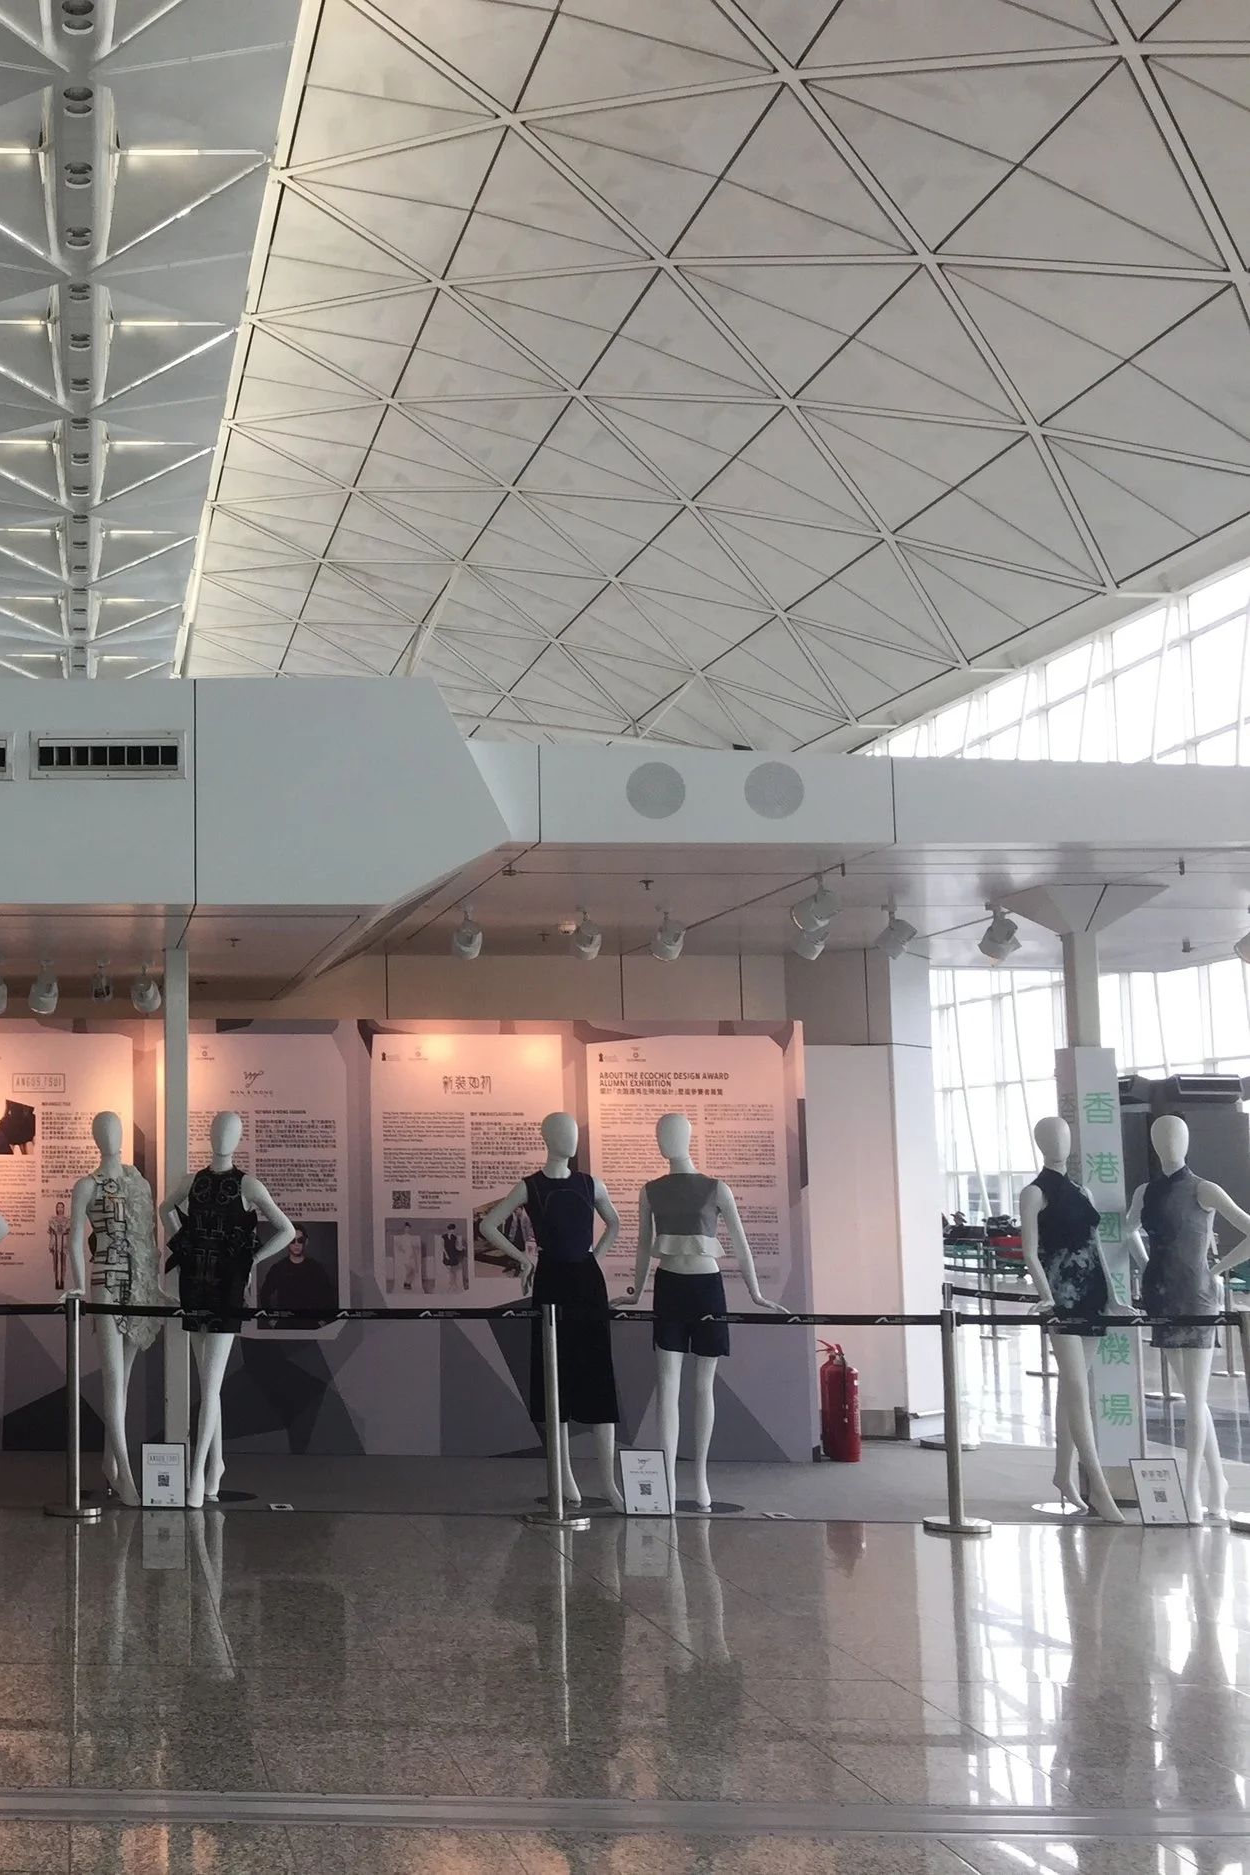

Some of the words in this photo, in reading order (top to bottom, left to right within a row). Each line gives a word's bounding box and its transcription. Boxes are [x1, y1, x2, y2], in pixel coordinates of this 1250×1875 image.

[599, 1072, 623, 1080] ABOUT
[625, 1072, 638, 1080] THE
[640, 1072, 672, 1080] ECOCHIC
[673, 1072, 700, 1080] DESIGN
[702, 1072, 729, 1080] AWARD
[599, 1080, 628, 1088] ALUMNI
[629, 1080, 672, 1088] EXHIBITION
